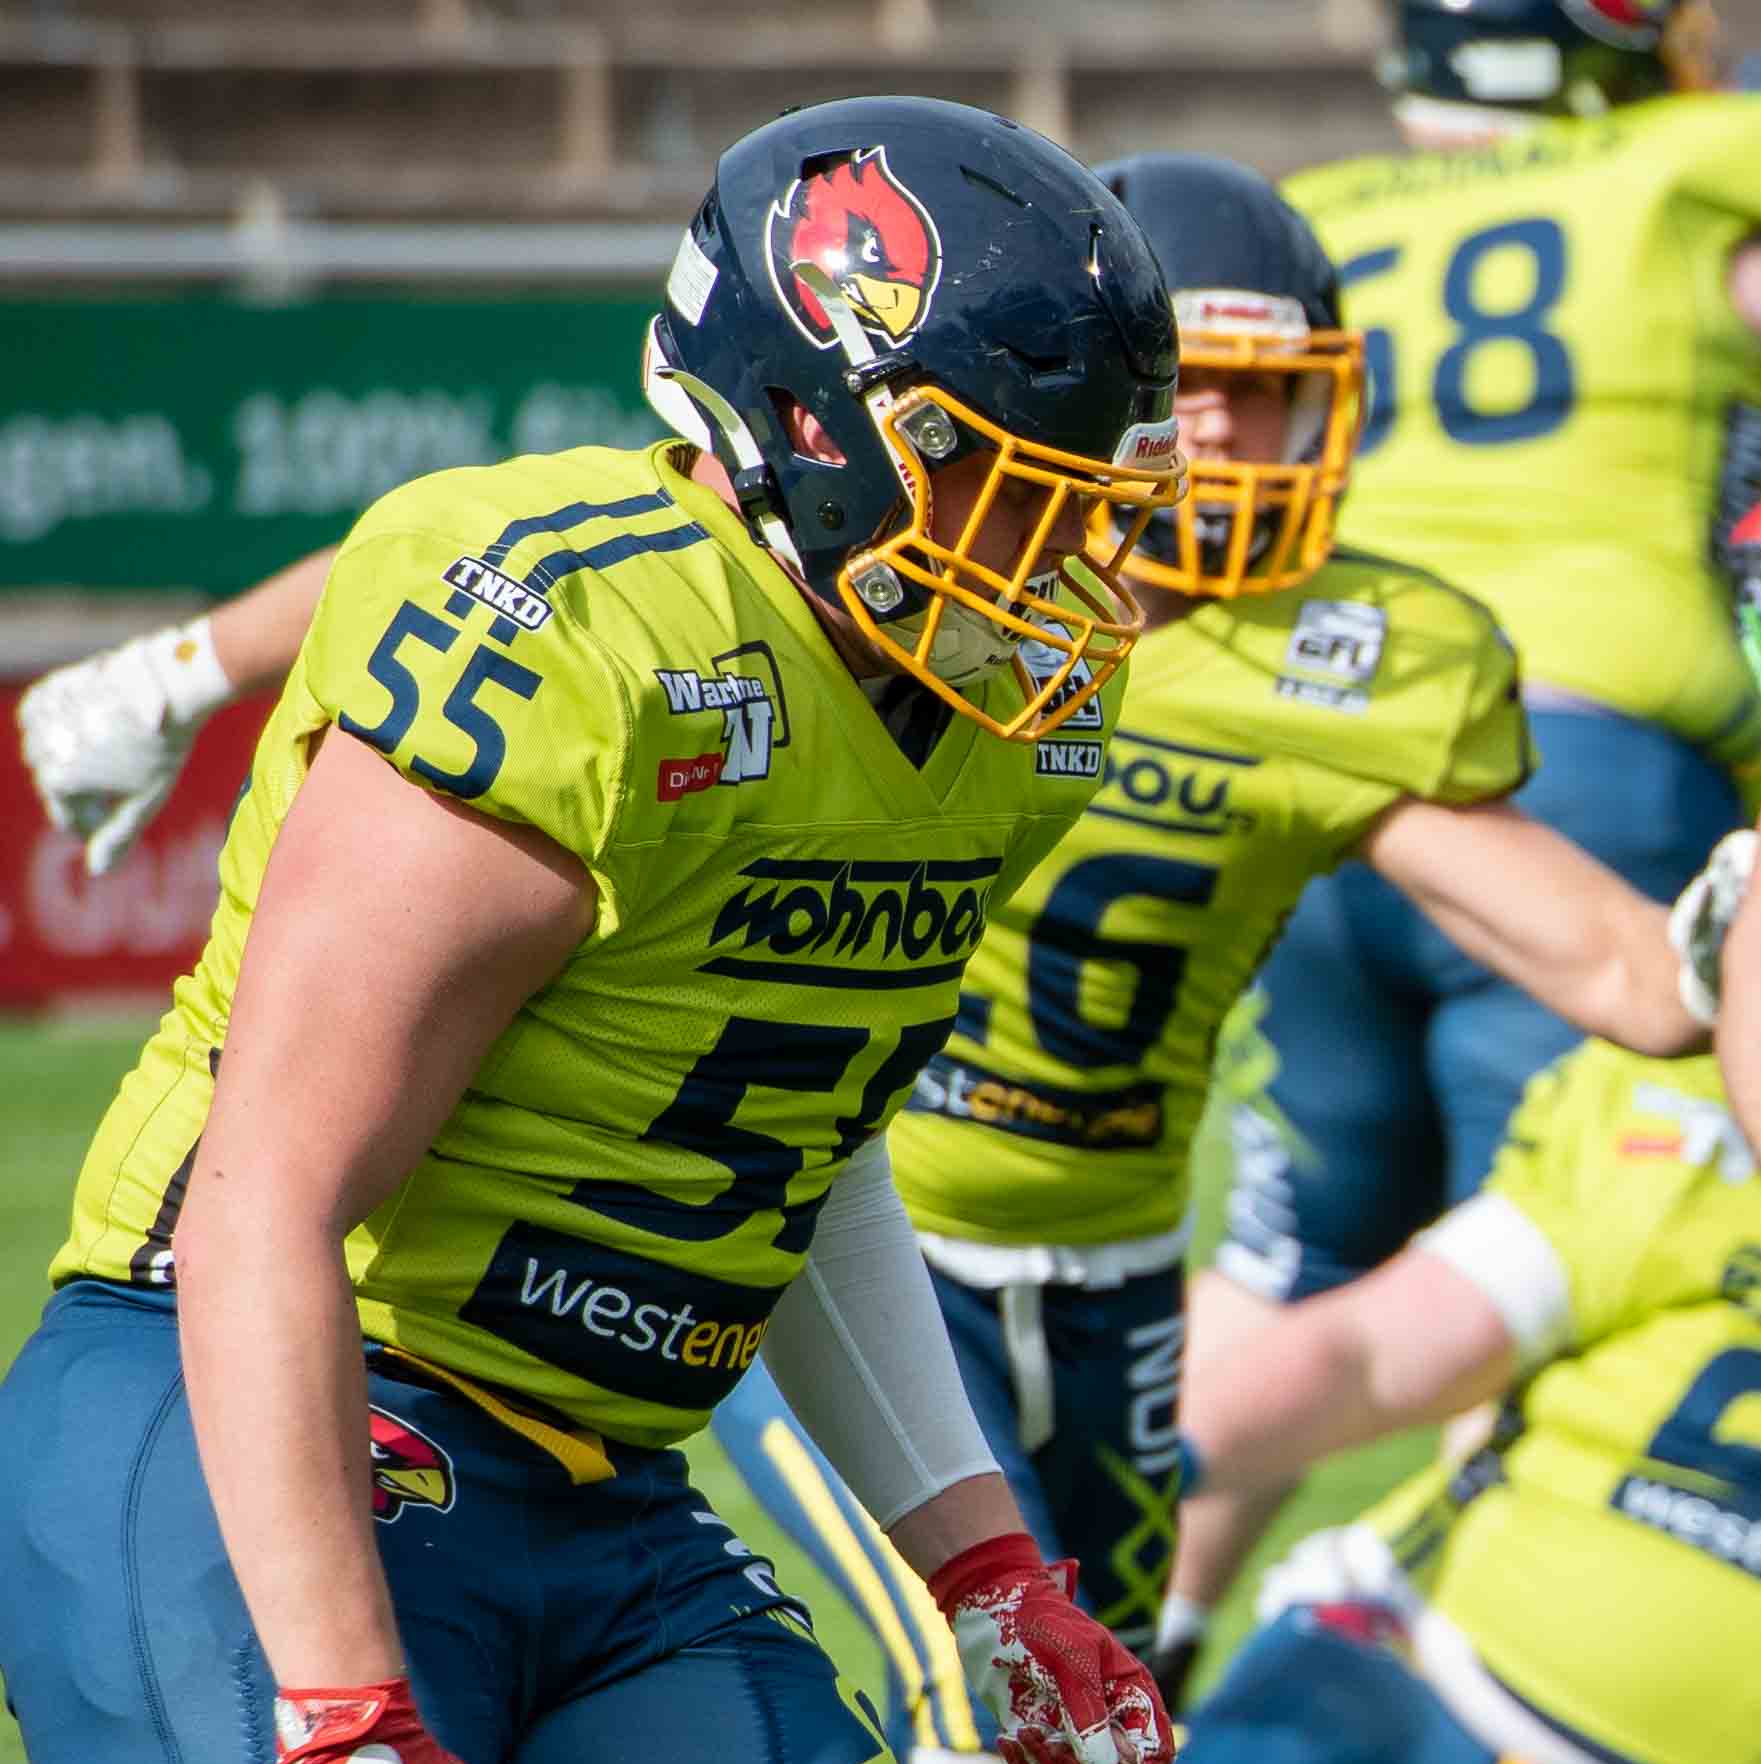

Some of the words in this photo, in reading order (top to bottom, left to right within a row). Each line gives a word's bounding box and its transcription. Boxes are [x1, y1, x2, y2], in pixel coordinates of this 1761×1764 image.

[452, 557, 548, 628] TNKD
[339, 600, 543, 800] 55
[1037, 740, 1101, 774] TNKD
[519, 1256, 769, 1372] westene
